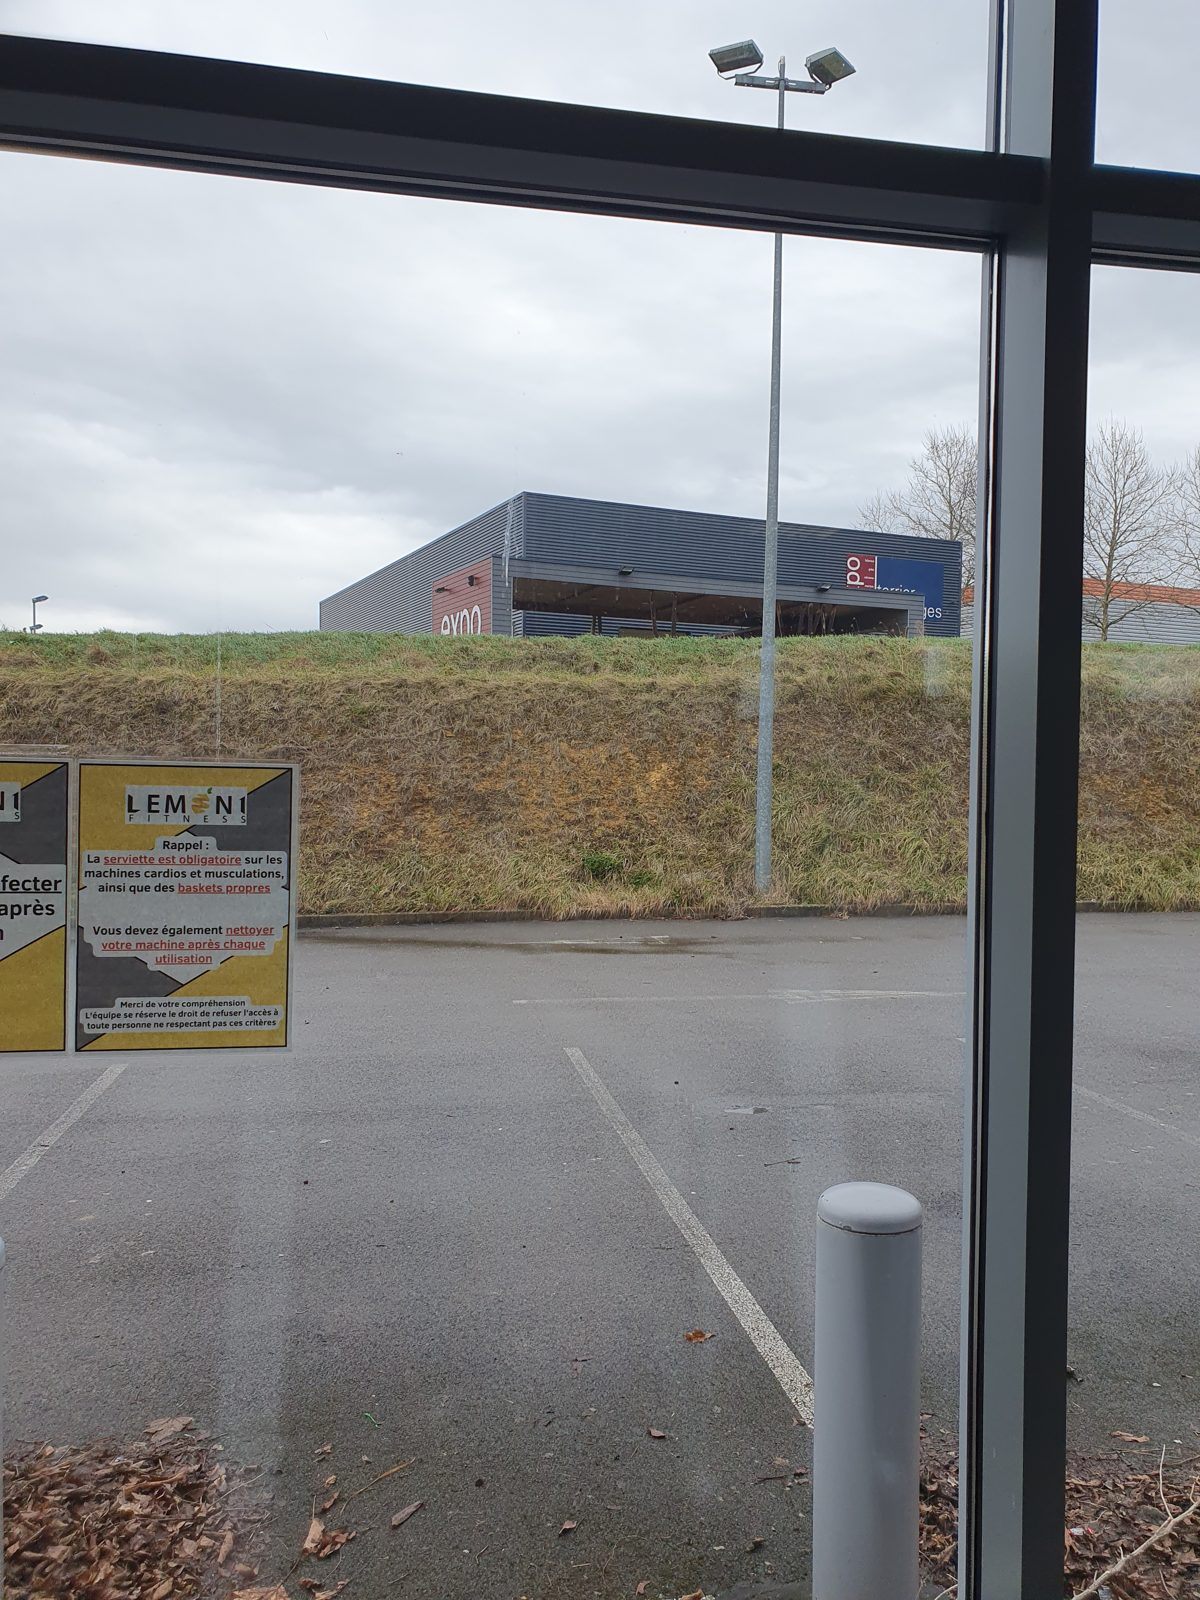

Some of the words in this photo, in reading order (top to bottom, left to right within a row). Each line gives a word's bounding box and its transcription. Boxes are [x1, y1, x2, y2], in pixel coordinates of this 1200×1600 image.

[128, 815, 246, 824] FITNESS
[162, 841, 203, 852] Rappel
[87, 854, 100, 864] La
[103, 855, 155, 865] serviette
[158, 856, 176, 864] est
[179, 855, 242, 866] obligatoire
[266, 855, 282, 864] les
[84, 869, 141, 878] machines
[143, 869, 187, 878] cardios
[190, 870, 201, 878] et
[204, 869, 285, 880] musculations,
[1, 875, 63, 892] fecter
[98, 883, 126, 893] ainsi
[129, 885, 151, 895] que
[154, 883, 175, 893] des
[178, 883, 222, 893] baskets
[226, 885, 271, 895] propres
[0, 899, 55, 919] après
[93, 926, 122, 935] Vous
[125, 926, 159, 935] devez
[161, 925, 223, 937] également
[225, 926, 274, 937] nettoyer
[101, 941, 132, 950] votre
[136, 940, 185, 949] machine
[188, 939, 220, 951] après
[223, 939, 266, 951] chaque
[155, 954, 212, 964] utilisation
[120, 1000, 144, 1008] Merci
[145, 1000, 156, 1008] de
[181, 1000, 246, 1009] compréhension
[86, 1012, 122, 1021] L'équipe
[135, 1011, 166, 1019] réserve
[168, 1010, 177, 1018] le
[178, 1010, 198, 1018] droit
[200, 1010, 211, 1018] de
[212, 1009, 241, 1017] refuser
[243, 1009, 271, 1017] l'accès
[87, 1022, 110, 1030] toute
[111, 1022, 151, 1031] personne
[166, 1021, 211, 1030] respectant
[212, 1021, 227, 1029] pas
[245, 1019, 276, 1027] critères
